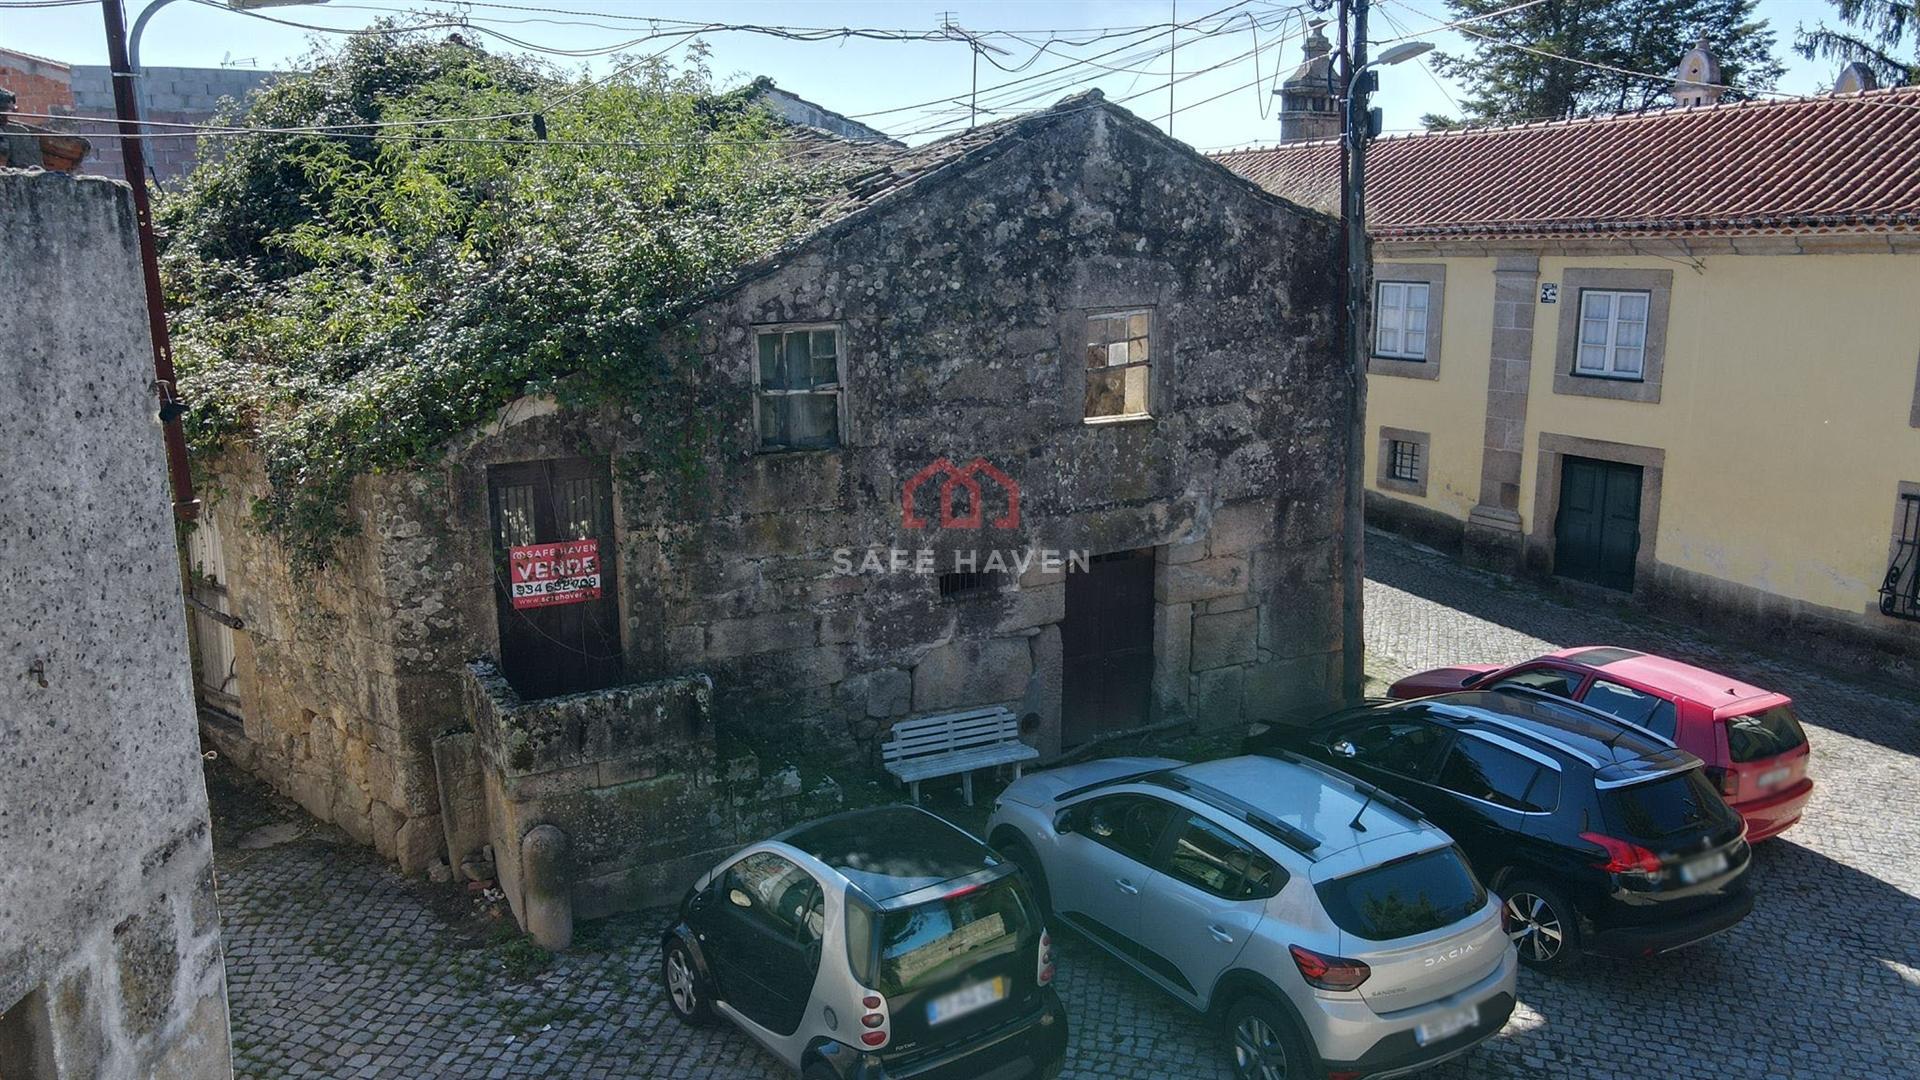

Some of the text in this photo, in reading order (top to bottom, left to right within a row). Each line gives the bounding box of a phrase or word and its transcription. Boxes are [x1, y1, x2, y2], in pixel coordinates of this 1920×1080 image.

[526, 544, 597, 558] SAFE HAVEN
[517, 556, 596, 580] VENDE
[1425, 944, 1474, 967] DACIA
